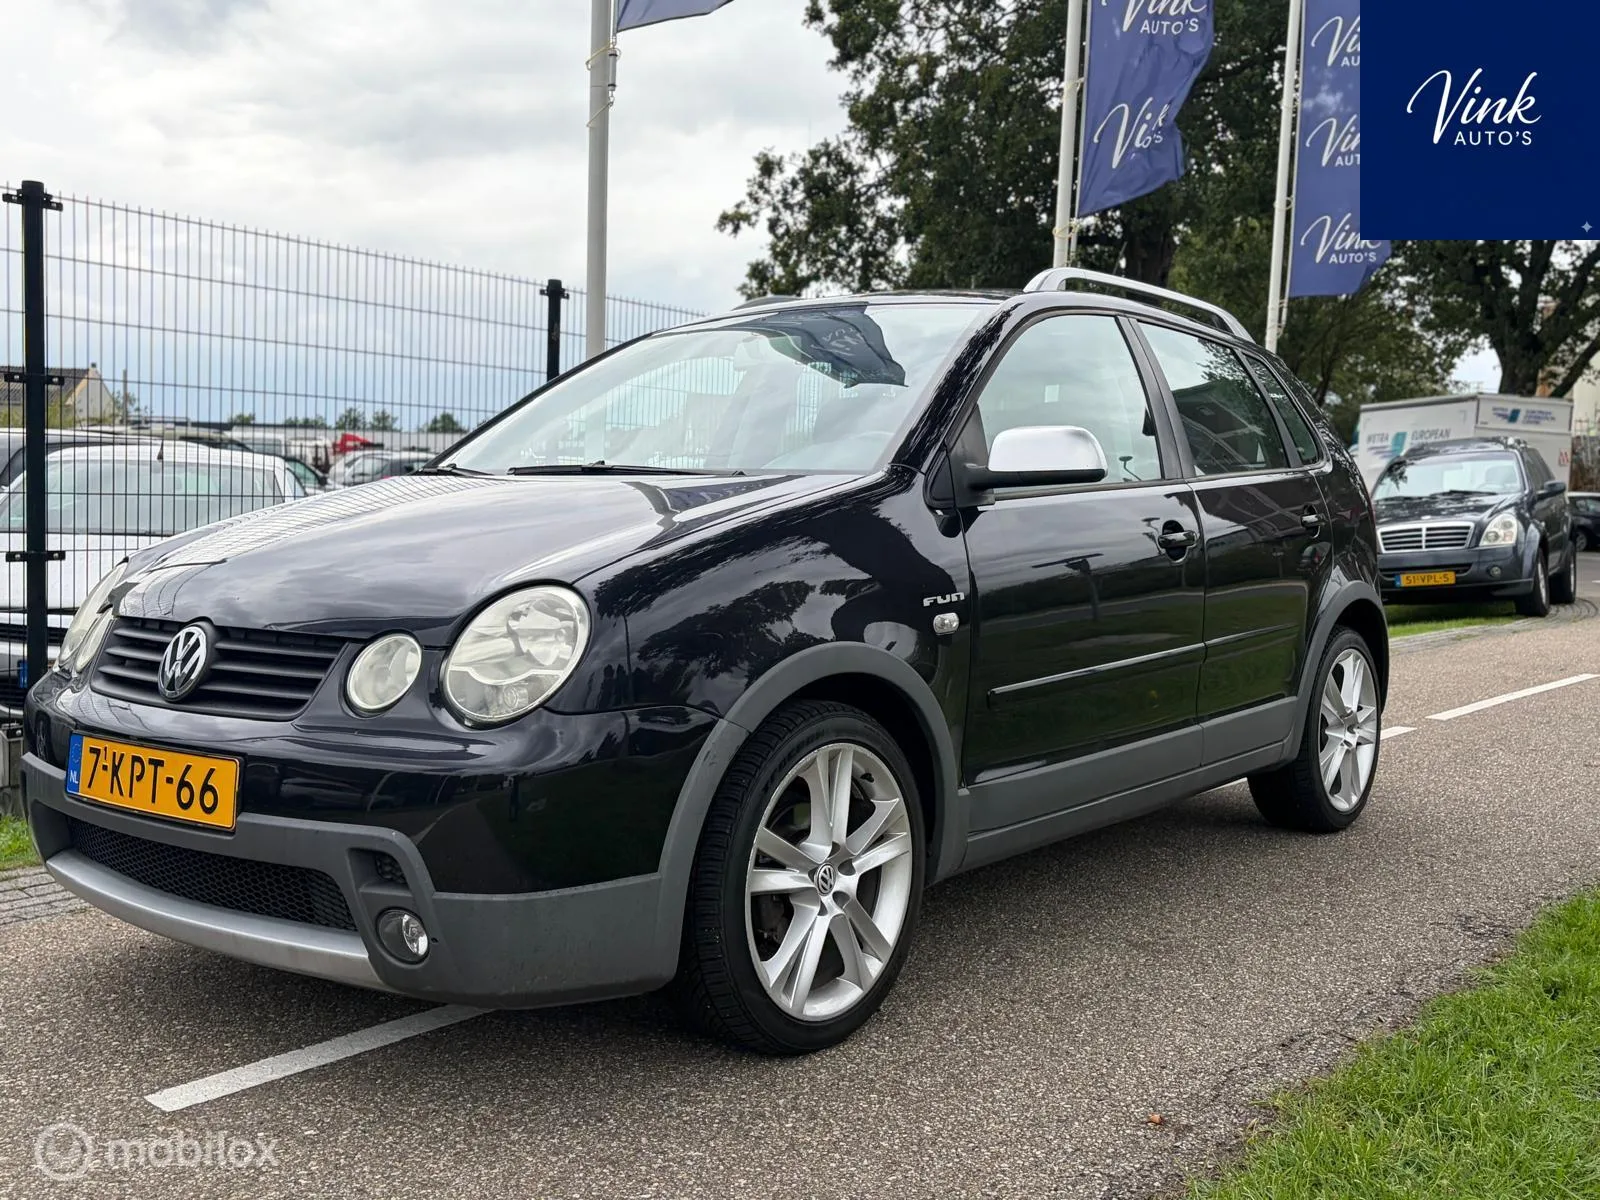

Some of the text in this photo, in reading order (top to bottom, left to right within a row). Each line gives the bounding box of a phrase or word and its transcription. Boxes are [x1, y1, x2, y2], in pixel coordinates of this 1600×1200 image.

[1140, 18, 1199, 35] AUTO'S
[1328, 251, 1377, 265] AUTO'S
[69, 772, 79, 785] NL
